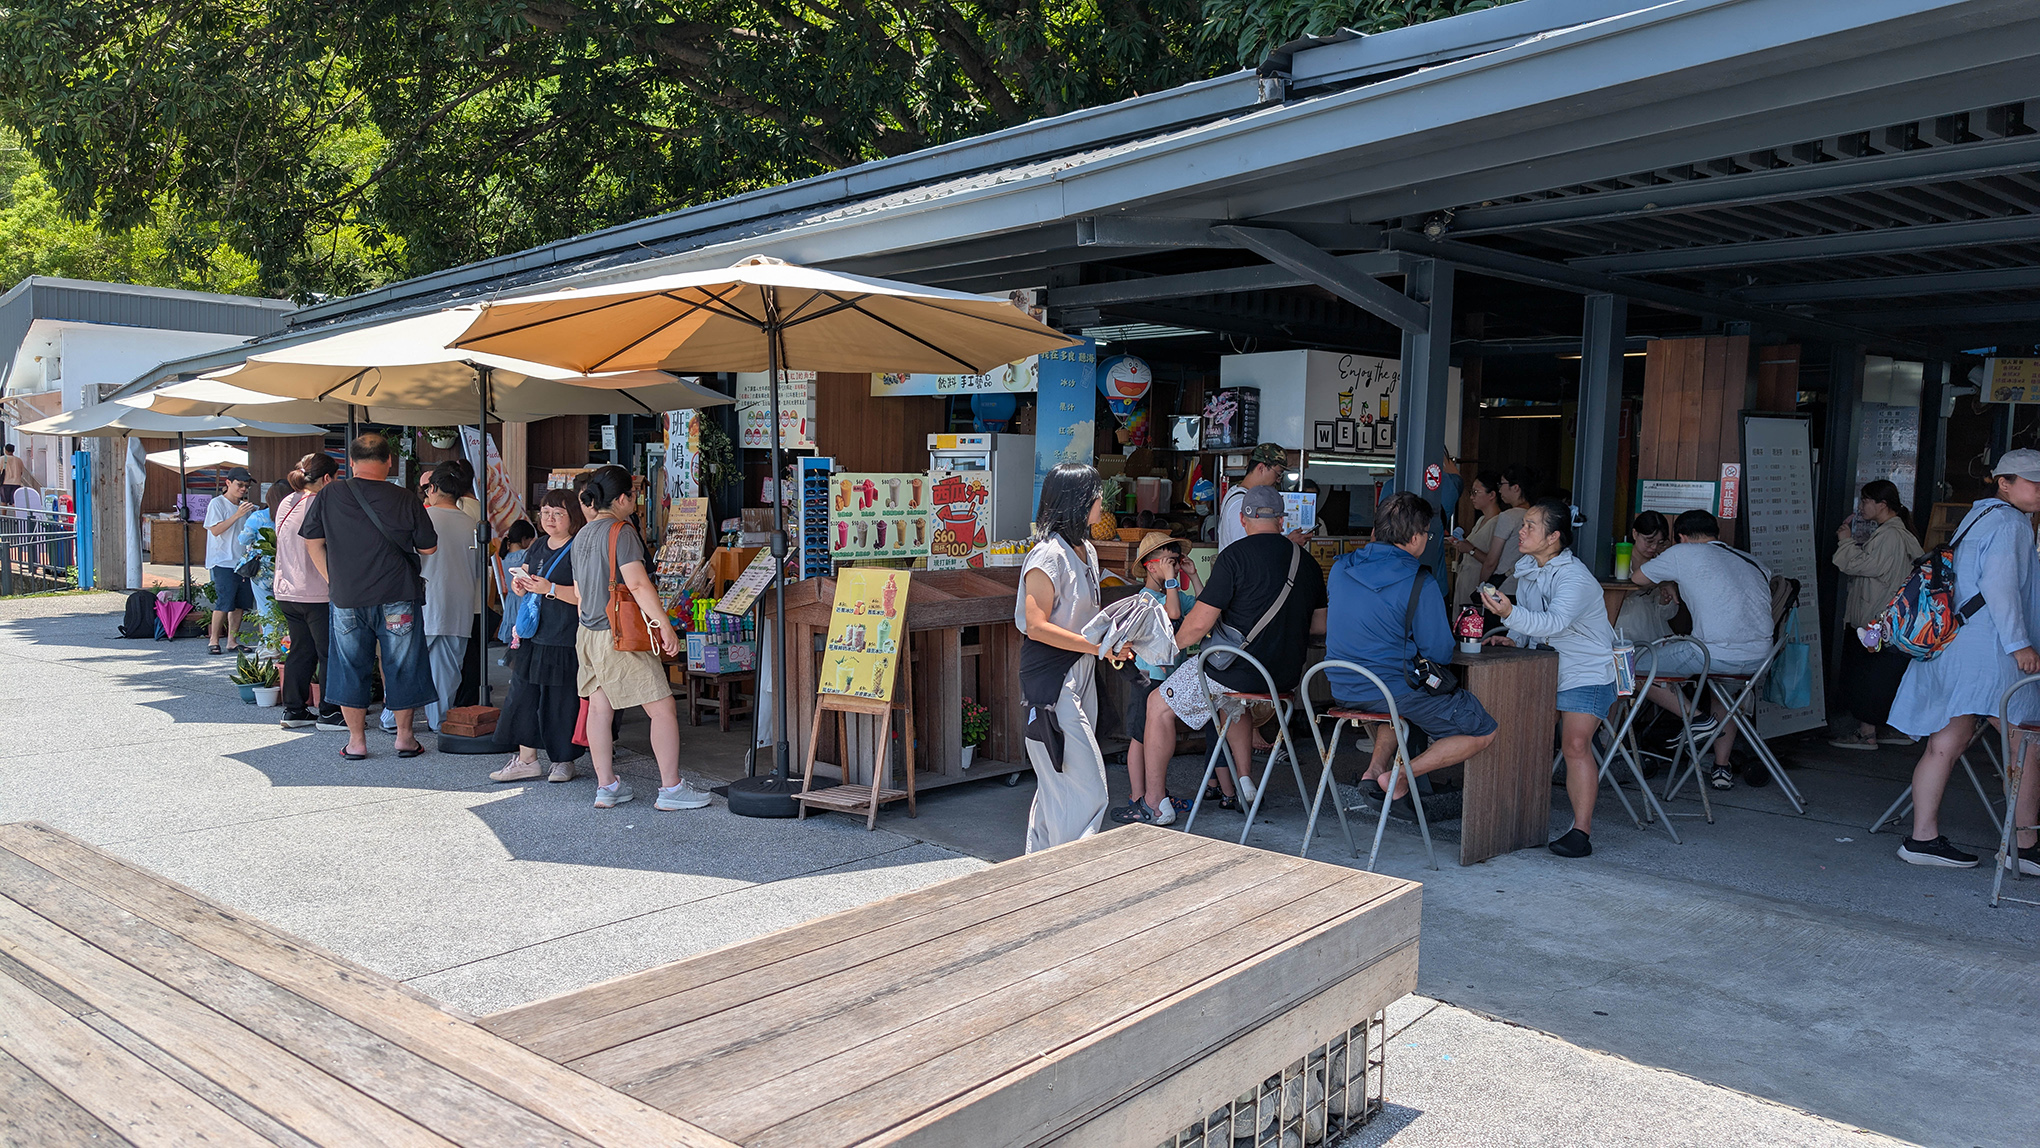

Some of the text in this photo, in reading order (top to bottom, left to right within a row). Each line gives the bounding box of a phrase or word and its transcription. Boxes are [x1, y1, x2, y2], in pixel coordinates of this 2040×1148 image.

[1338, 354, 1373, 390] Enjoy
[1374, 360, 1390, 383] the
[937, 376, 957, 390] 飲料
[932, 482, 989, 505] 西瓜汁
[1722, 481, 1734, 517] 禁止吸菸
[934, 528, 956, 543] $60
[946, 541, 968, 557] 100
